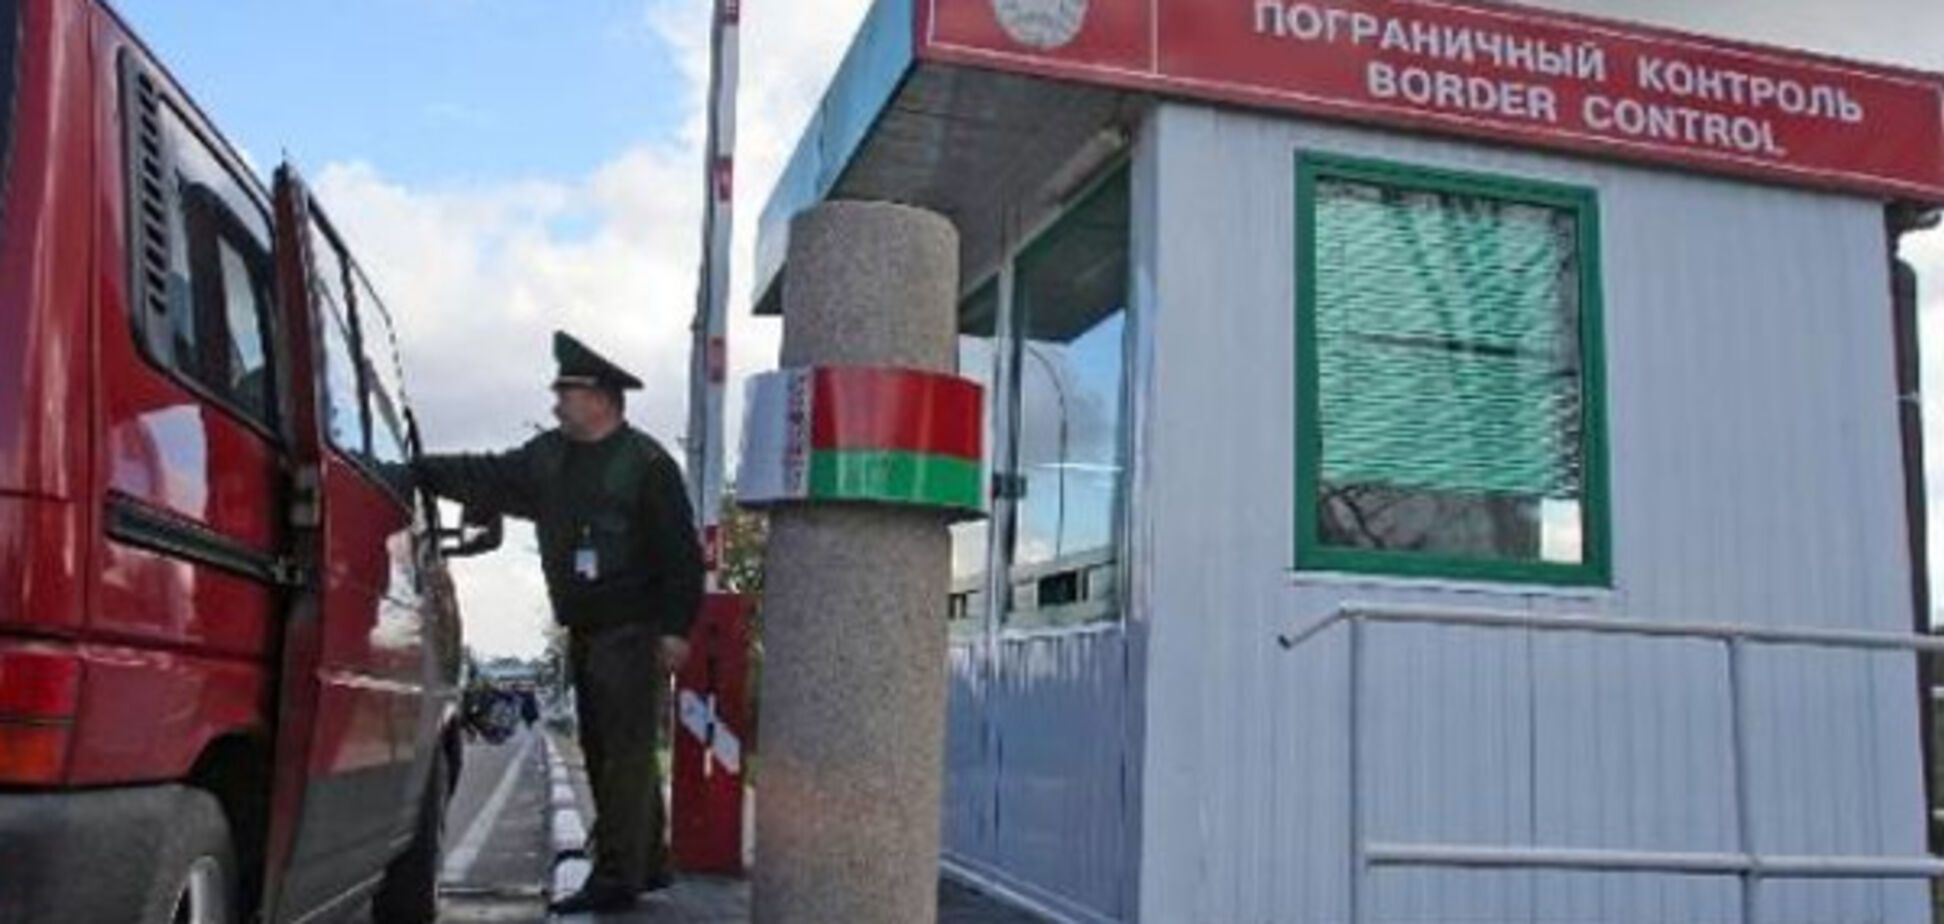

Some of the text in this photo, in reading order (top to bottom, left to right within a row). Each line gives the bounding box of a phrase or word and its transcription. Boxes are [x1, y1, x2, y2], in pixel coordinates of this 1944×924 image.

[1254, 0, 1864, 122] ПОГРАНИЧНЫЙ КОНТРОЛЬ
[1367, 63, 1786, 154] BORDER CONTROL
